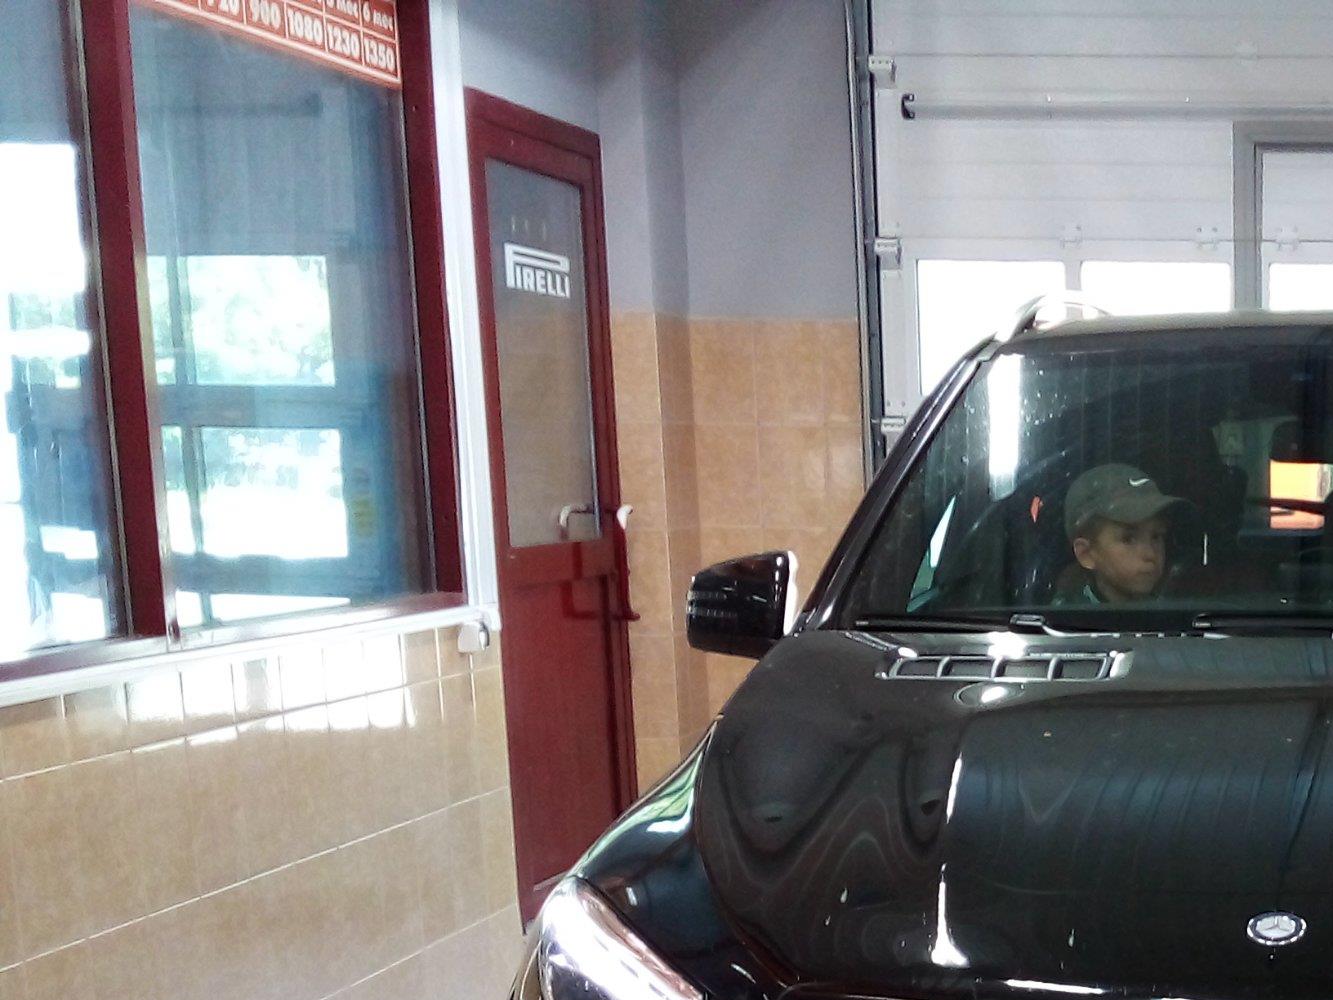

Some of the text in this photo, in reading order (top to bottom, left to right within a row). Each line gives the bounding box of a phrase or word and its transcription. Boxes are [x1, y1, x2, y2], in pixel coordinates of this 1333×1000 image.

[288, 9, 323, 45] 1080
[328, 24, 360, 59] 1230
[364, 38, 395, 71] 1350
[504, 242, 570, 299] PIRELLI
